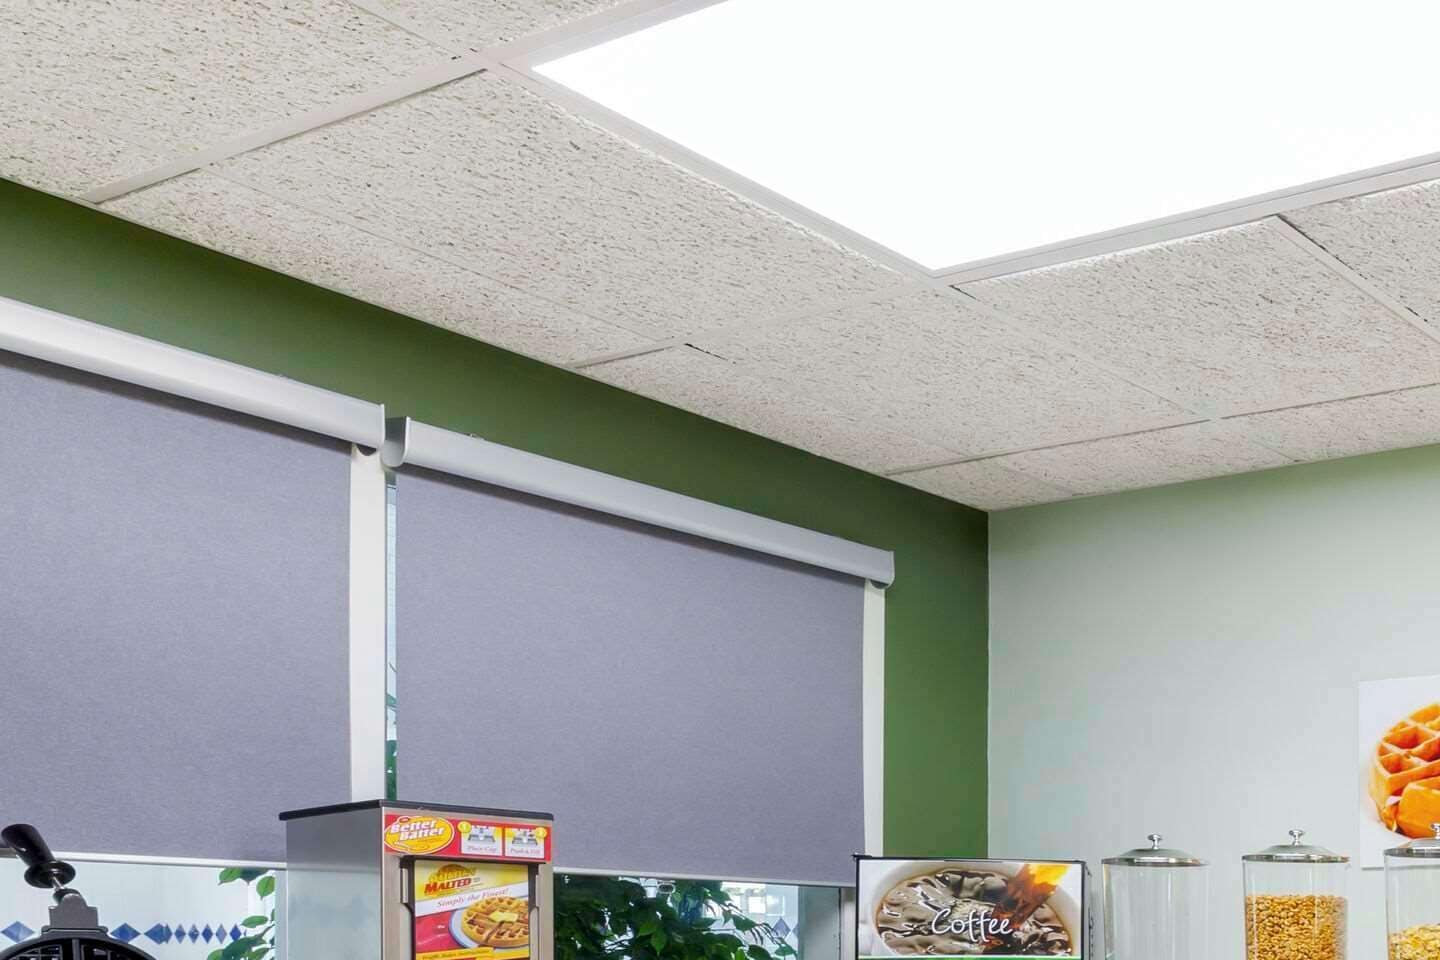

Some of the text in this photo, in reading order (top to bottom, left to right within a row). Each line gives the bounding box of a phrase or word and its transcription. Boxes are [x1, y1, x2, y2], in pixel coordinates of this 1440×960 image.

[391, 819, 437, 834] Better
[399, 827, 445, 841] Batter
[931, 908, 1014, 943] Coffee
